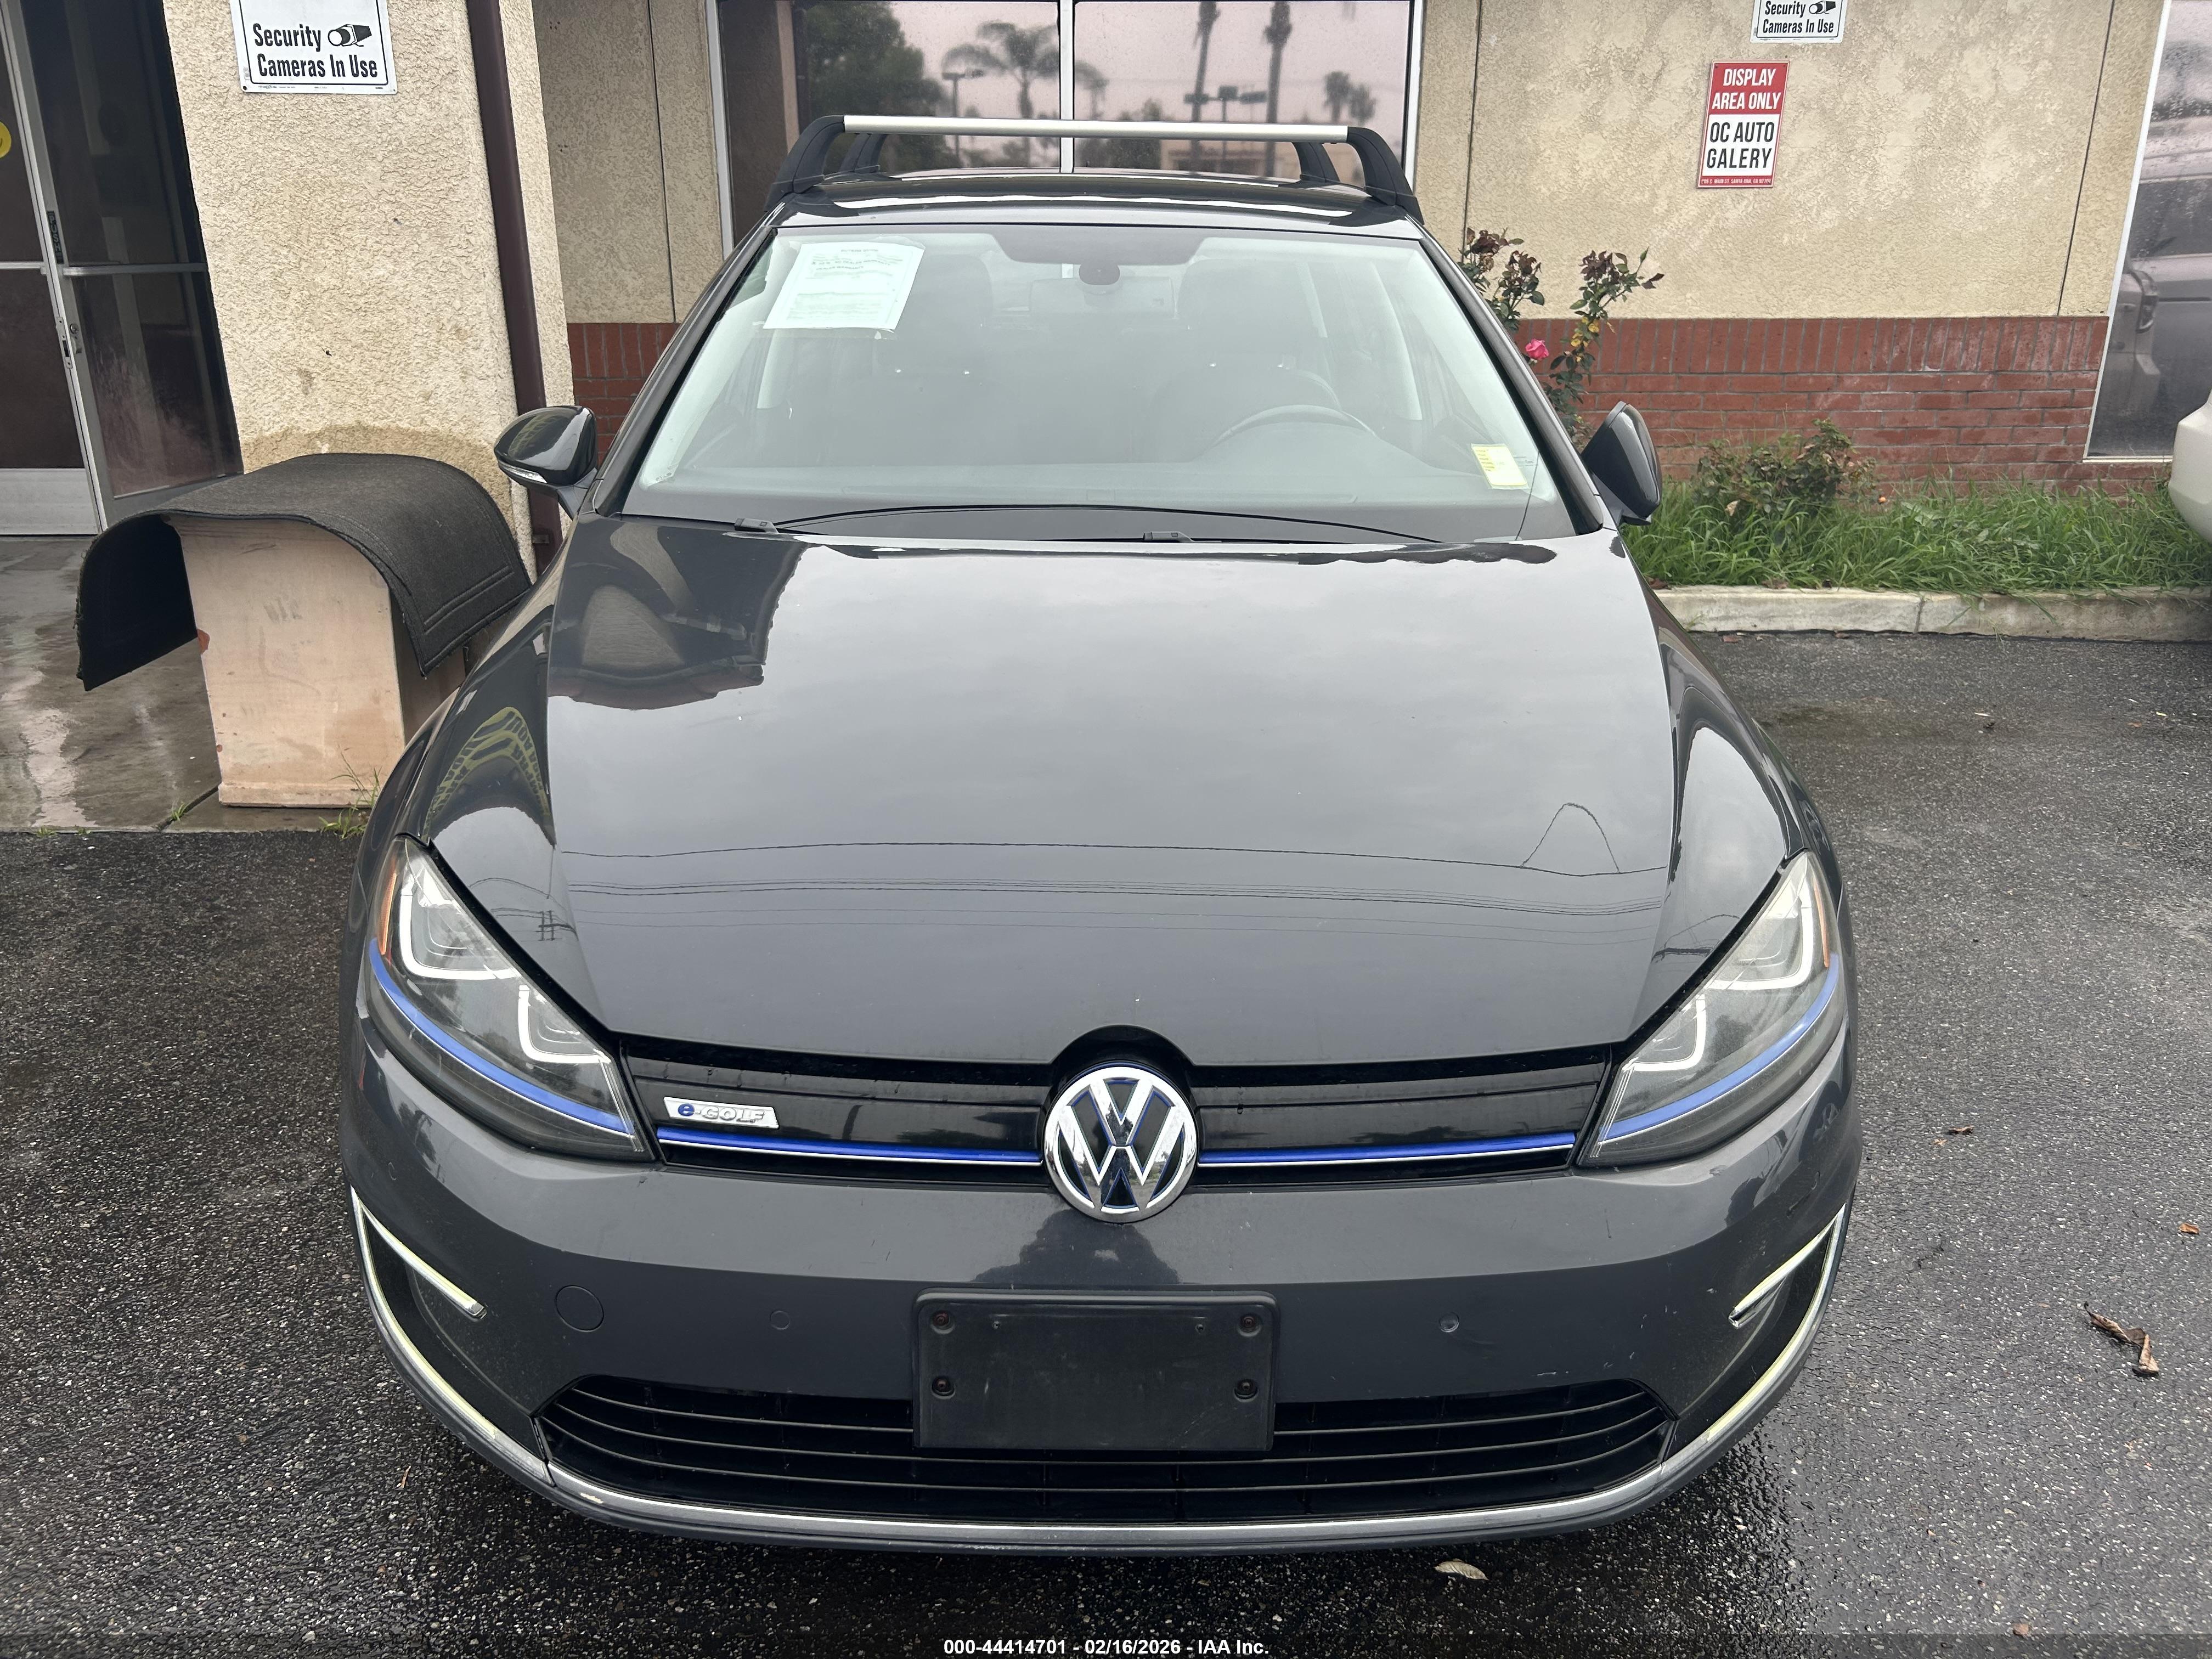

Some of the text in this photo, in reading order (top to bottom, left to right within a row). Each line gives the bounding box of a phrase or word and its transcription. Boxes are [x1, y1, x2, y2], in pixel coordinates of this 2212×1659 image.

[1765, 1, 1806, 18] Security
[1763, 19, 1833, 33] Cameras In Use
[253, 23, 321, 52] Security
[257, 53, 378, 78] Cameras In Use
[1723, 69, 1776, 86] DISPLAY
[1712, 92, 1781, 110] AREA ONLY
[1710, 122, 1774, 143] OC AUTO
[1707, 148, 1772, 168] GALERY
[49, 215, 61, 252] PUSH
[678, 1103, 765, 1124] e-GOLF
